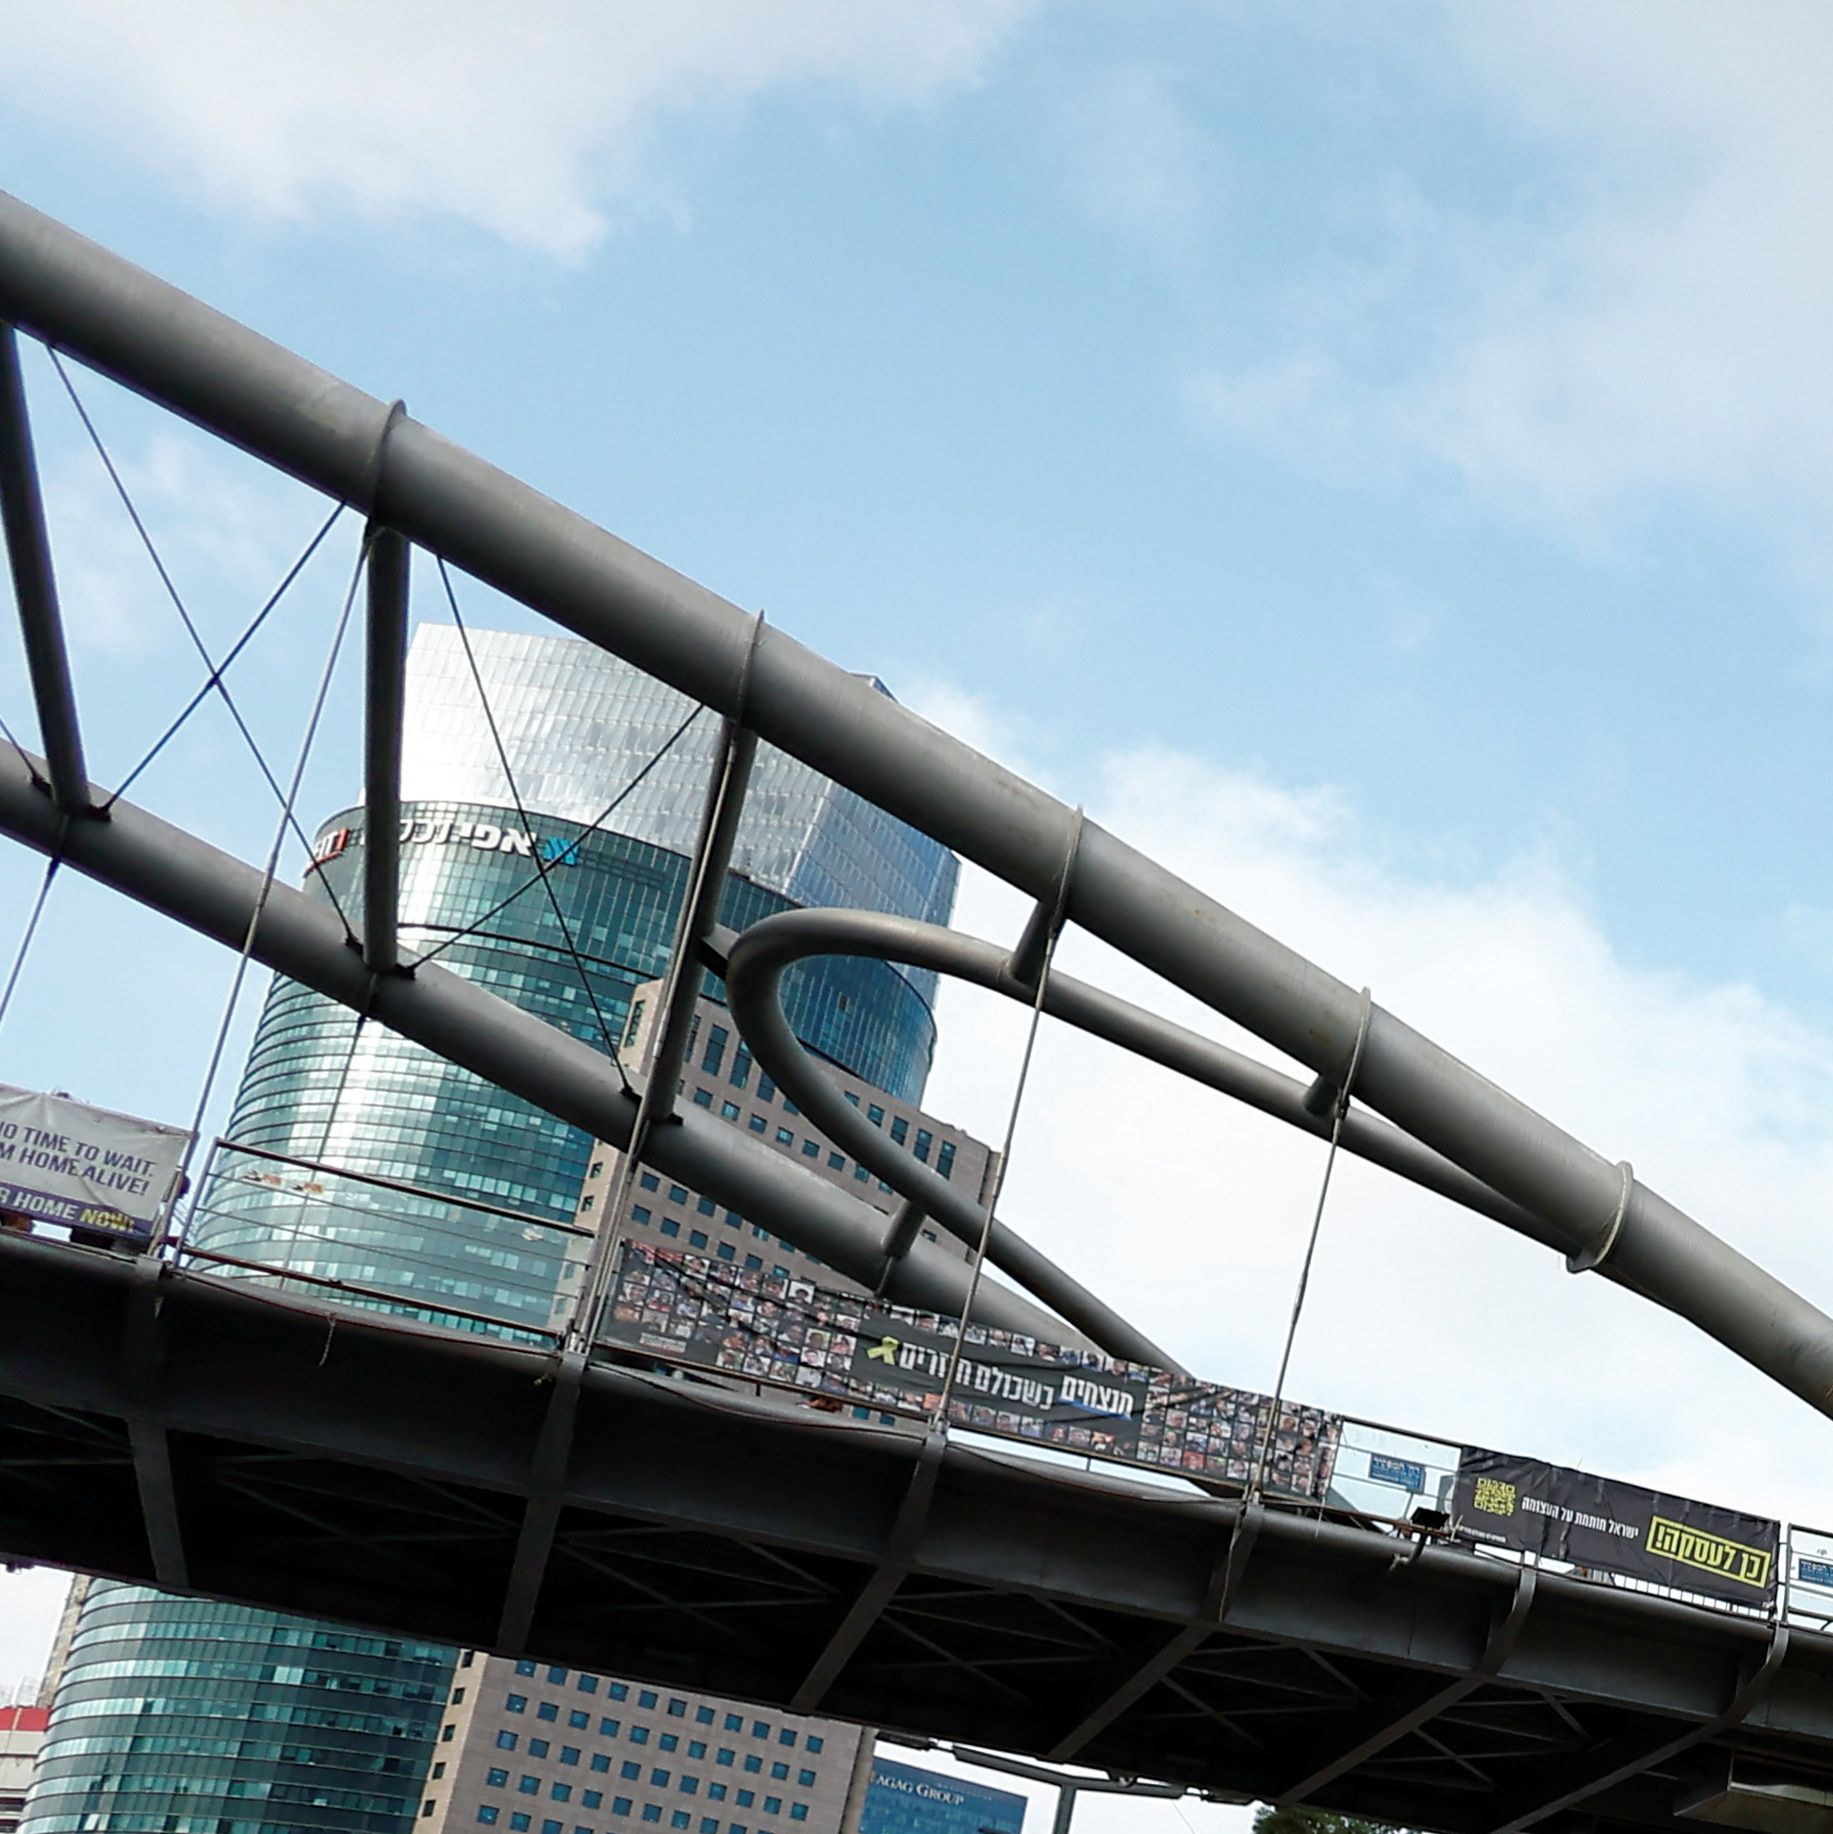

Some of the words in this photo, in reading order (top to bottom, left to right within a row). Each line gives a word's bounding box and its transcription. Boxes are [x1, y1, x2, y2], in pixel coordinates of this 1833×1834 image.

[18, 1147, 80, 1177] HOME
[82, 1166, 149, 1196] ALIVE!
[24, 1126, 71, 1152] TIME
[76, 1140, 100, 1161] TO
[104, 1150, 156, 1177] WAIT.
[14, 1191, 79, 1220] HOME
[80, 1207, 136, 1233] NOW!
[900, 1341, 971, 1387] חזרים
[973, 1364, 1055, 1411] כשכולם
[1560, 1506, 1574, 1522] על
[1607, 1518, 1640, 1540] ישראל
[1655, 1524, 1737, 1571] לעסקה!
[1740, 1551, 1761, 1580] כן
